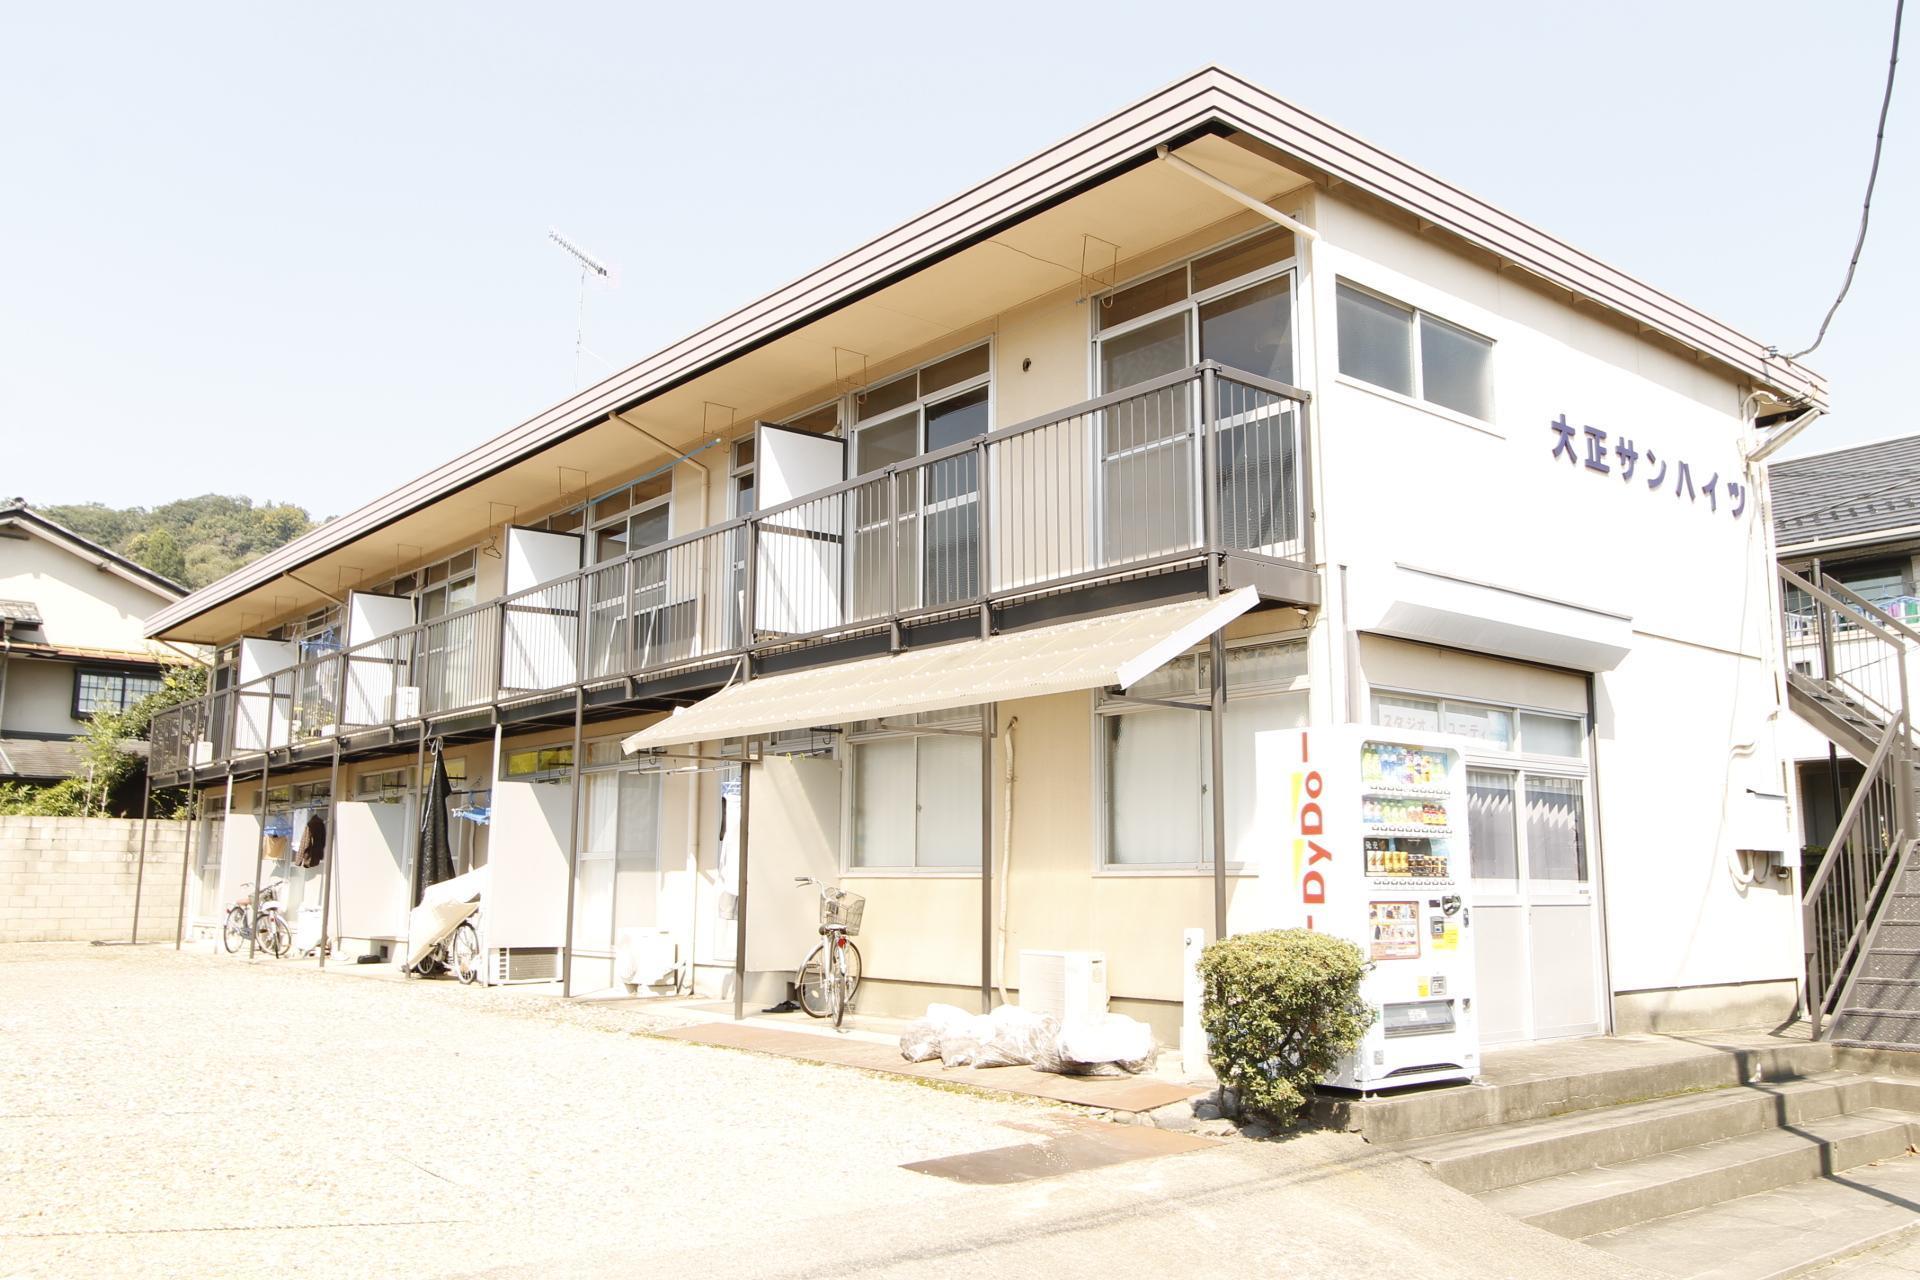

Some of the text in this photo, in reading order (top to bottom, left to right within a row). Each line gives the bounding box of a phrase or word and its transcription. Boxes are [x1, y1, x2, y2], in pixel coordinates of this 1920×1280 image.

[1551, 413, 1746, 518] 大正サンハイツ
[1301, 770, 1333, 904] DyDo
